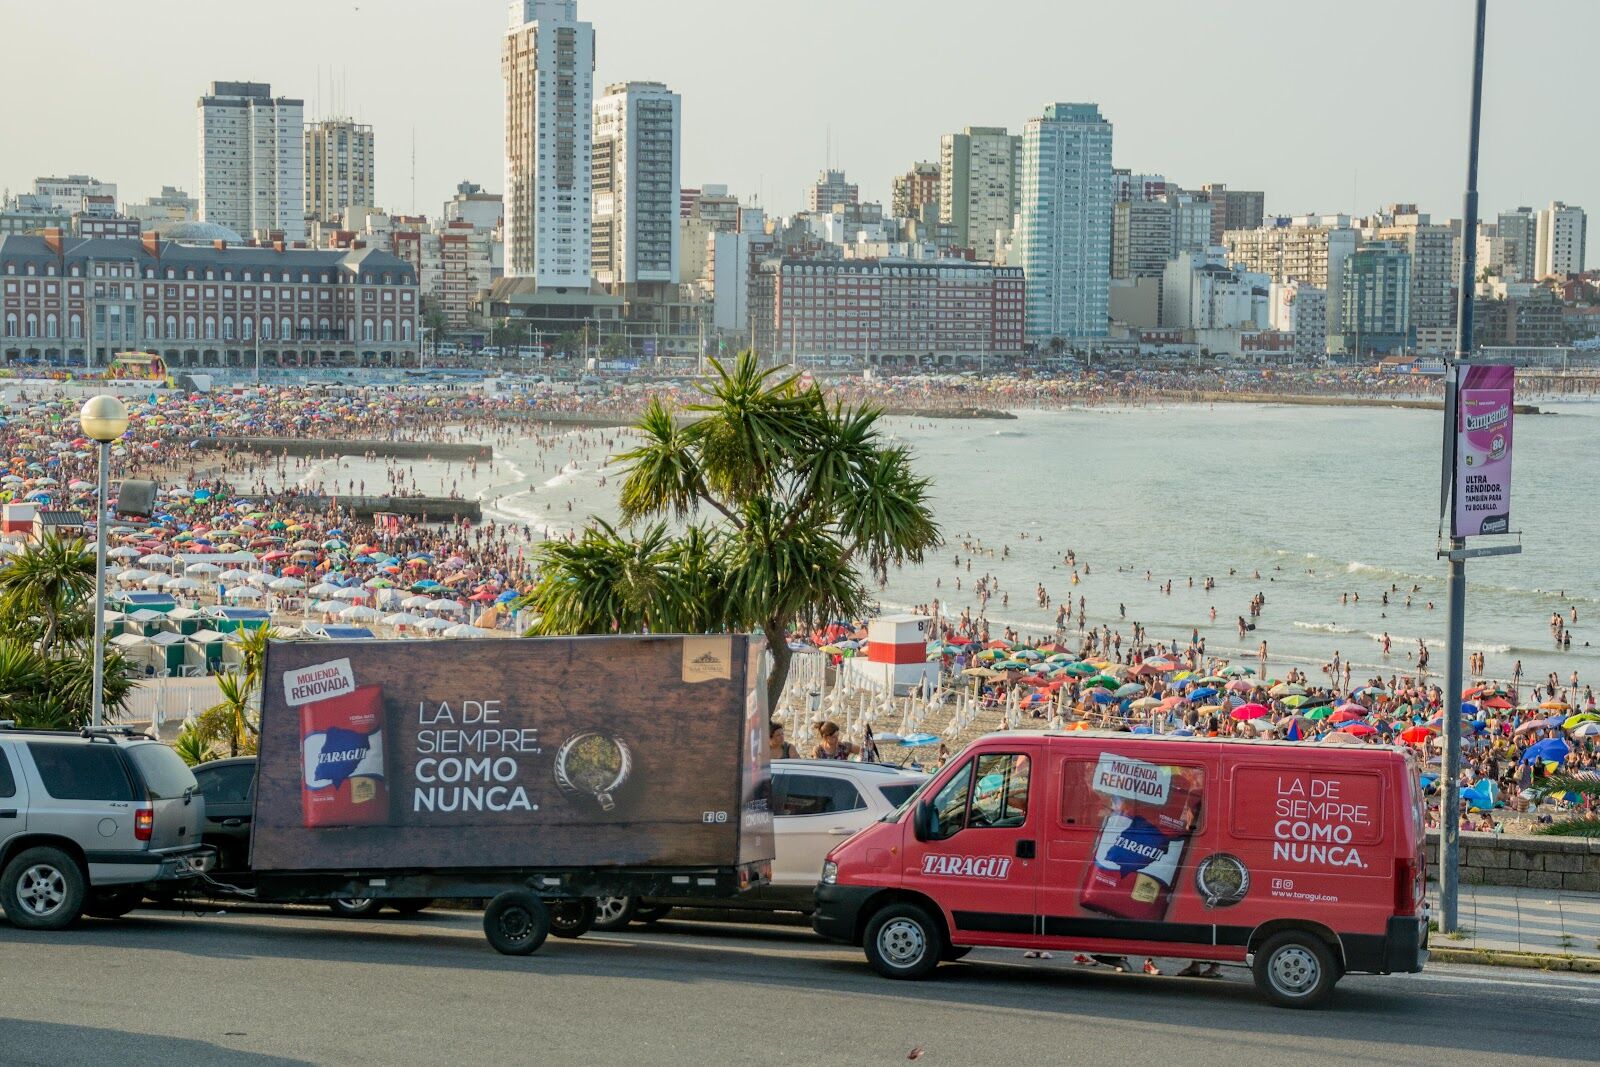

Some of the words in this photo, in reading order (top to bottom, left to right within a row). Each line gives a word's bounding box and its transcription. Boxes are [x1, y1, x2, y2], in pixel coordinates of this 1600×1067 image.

[1492, 438, 1503, 450] 80
[1465, 475, 1487, 484] ULTRA
[1465, 484, 1502, 493] RENDIDOR.
[917, 621, 924, 631] 8
[291, 676, 350, 700] RENOVADA
[297, 667, 340, 685] MOLIENDA
[419, 701, 455, 724] LA
[462, 700, 501, 724] DE
[416, 728, 542, 754] SIEMPRE,
[415, 756, 518, 783] COMO
[1111, 761, 1158, 781] MOLIENDA
[1100, 772, 1163, 798] RENOVADA
[1278, 777, 1305, 796] LA
[1311, 780, 1340, 799] DE
[413, 786, 539, 812] NUNCA.
[1275, 799, 1371, 826] SIEMPRE,
[1274, 820, 1352, 844] COMO
[1273, 842, 1369, 869] NUNCA.
